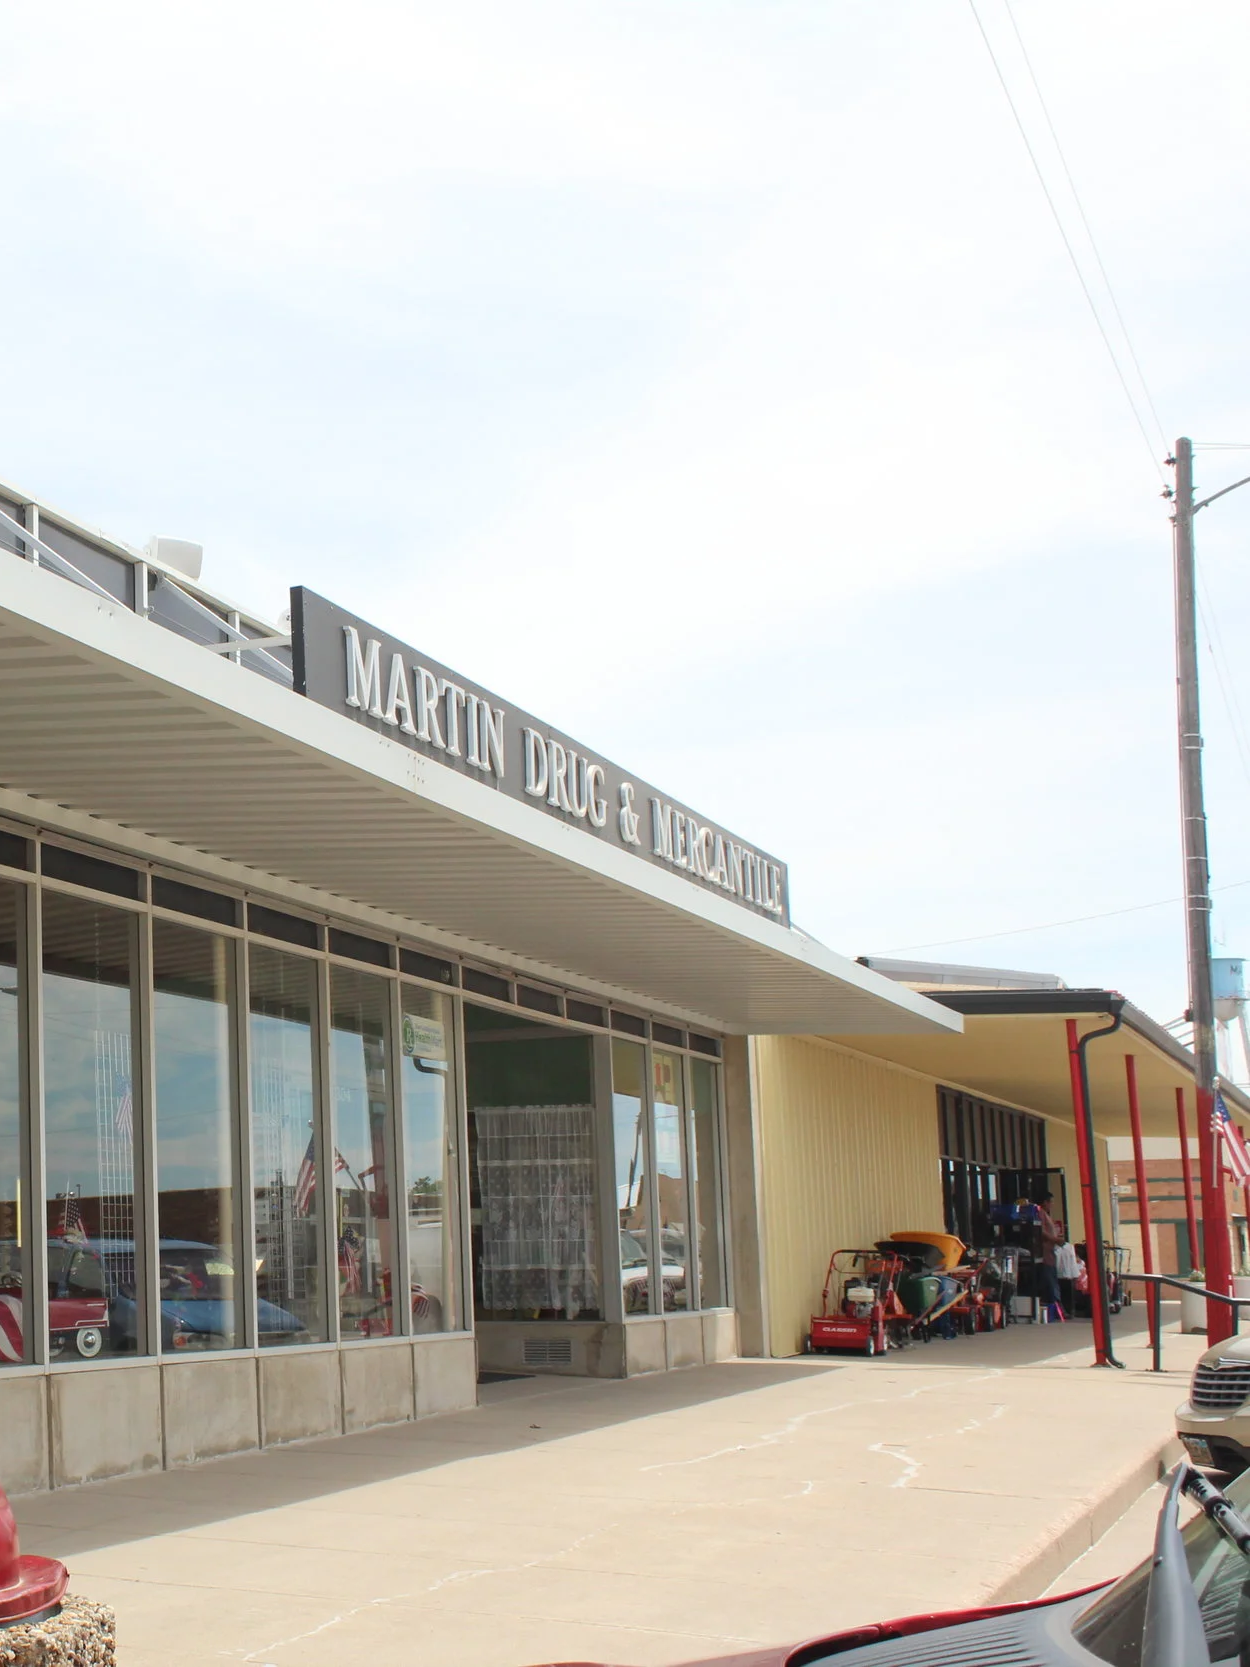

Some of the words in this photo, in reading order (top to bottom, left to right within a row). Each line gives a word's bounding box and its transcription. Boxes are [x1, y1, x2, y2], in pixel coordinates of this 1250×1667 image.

[342, 625, 505, 778] MARTIN
[522, 727, 608, 828] DRUG
[619, 781, 642, 846] &
[650, 797, 783, 916] MERCANTILE
